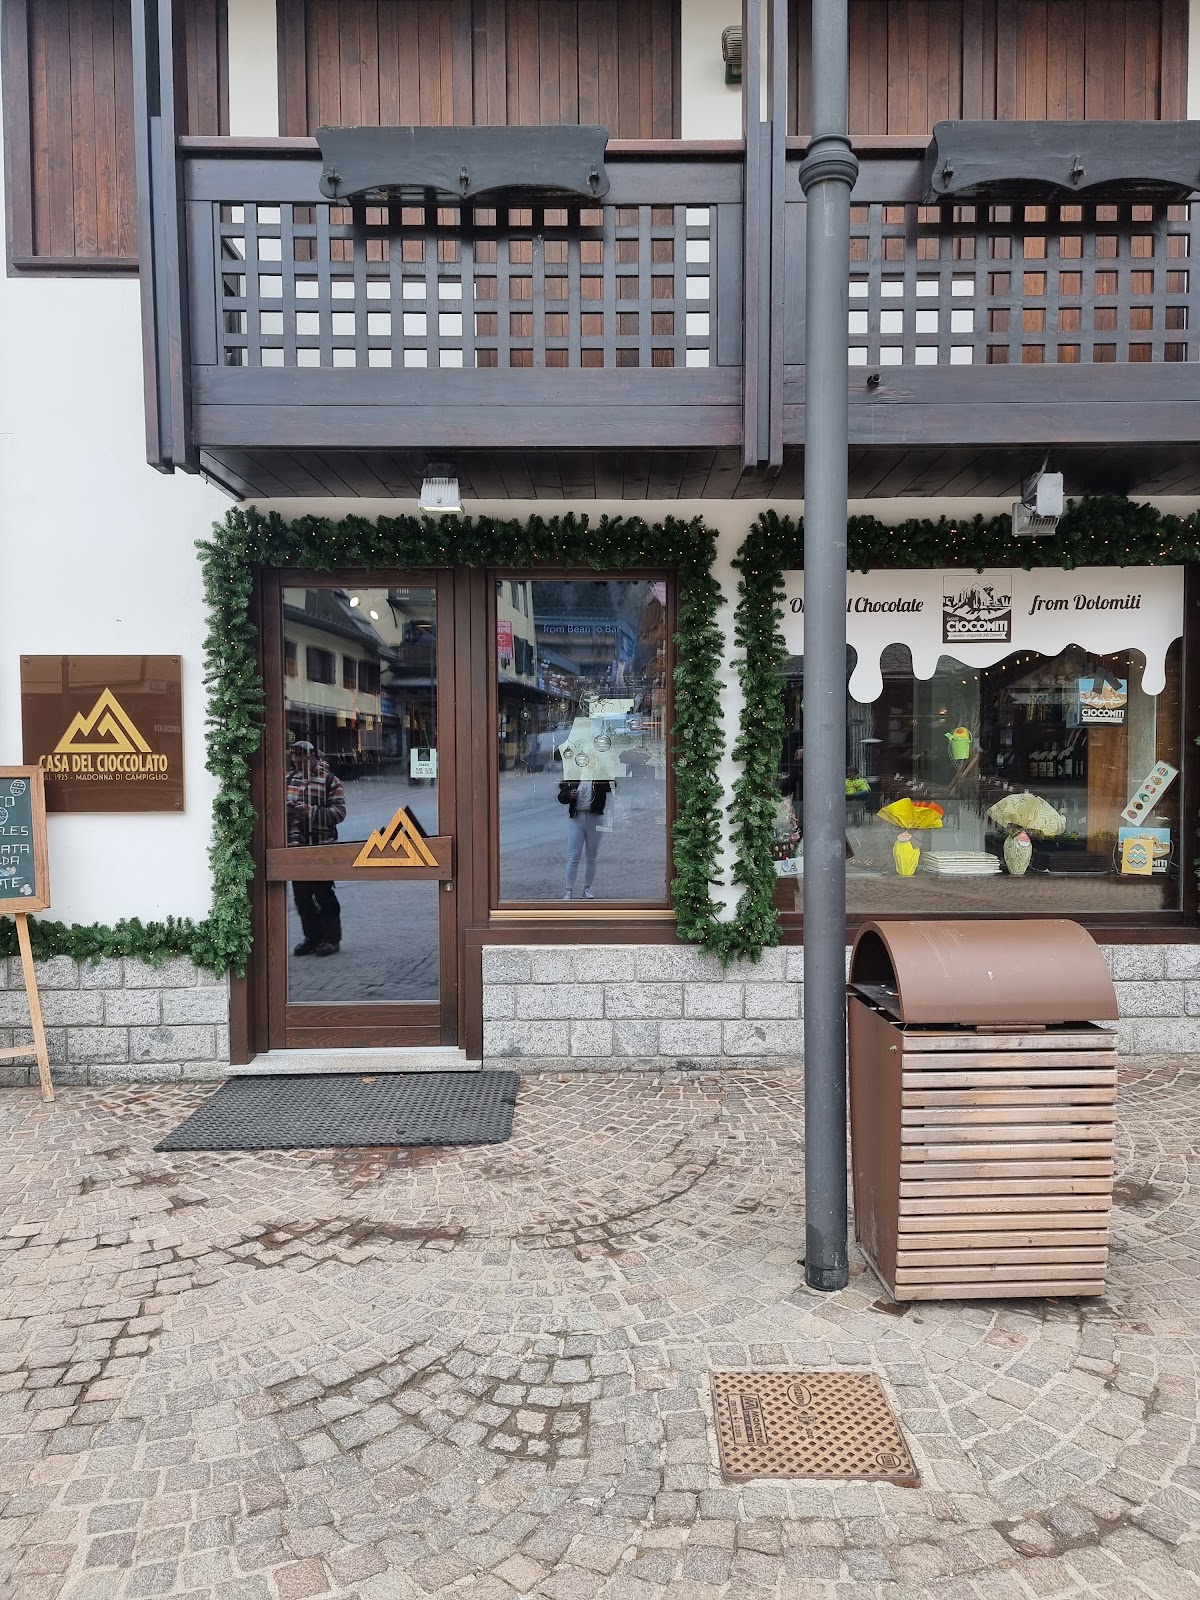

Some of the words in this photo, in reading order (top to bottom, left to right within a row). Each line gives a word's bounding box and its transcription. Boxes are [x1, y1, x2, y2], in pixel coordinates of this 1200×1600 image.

[854, 596, 924, 613] Chocolate
[1028, 595, 1069, 615] from
[1073, 594, 1141, 610] Dolomiti
[543, 624, 565, 633] from
[567, 624, 591, 633] Bean
[605, 624, 621, 633] Bar
[946, 620, 1008, 632] CIOCOMITI
[72, 754, 95, 772] DEL
[97, 754, 168, 772] CIOCCOLATO
[75, 773, 114, 781] MADONNA
[125, 773, 169, 781] CAMPIGLIO
